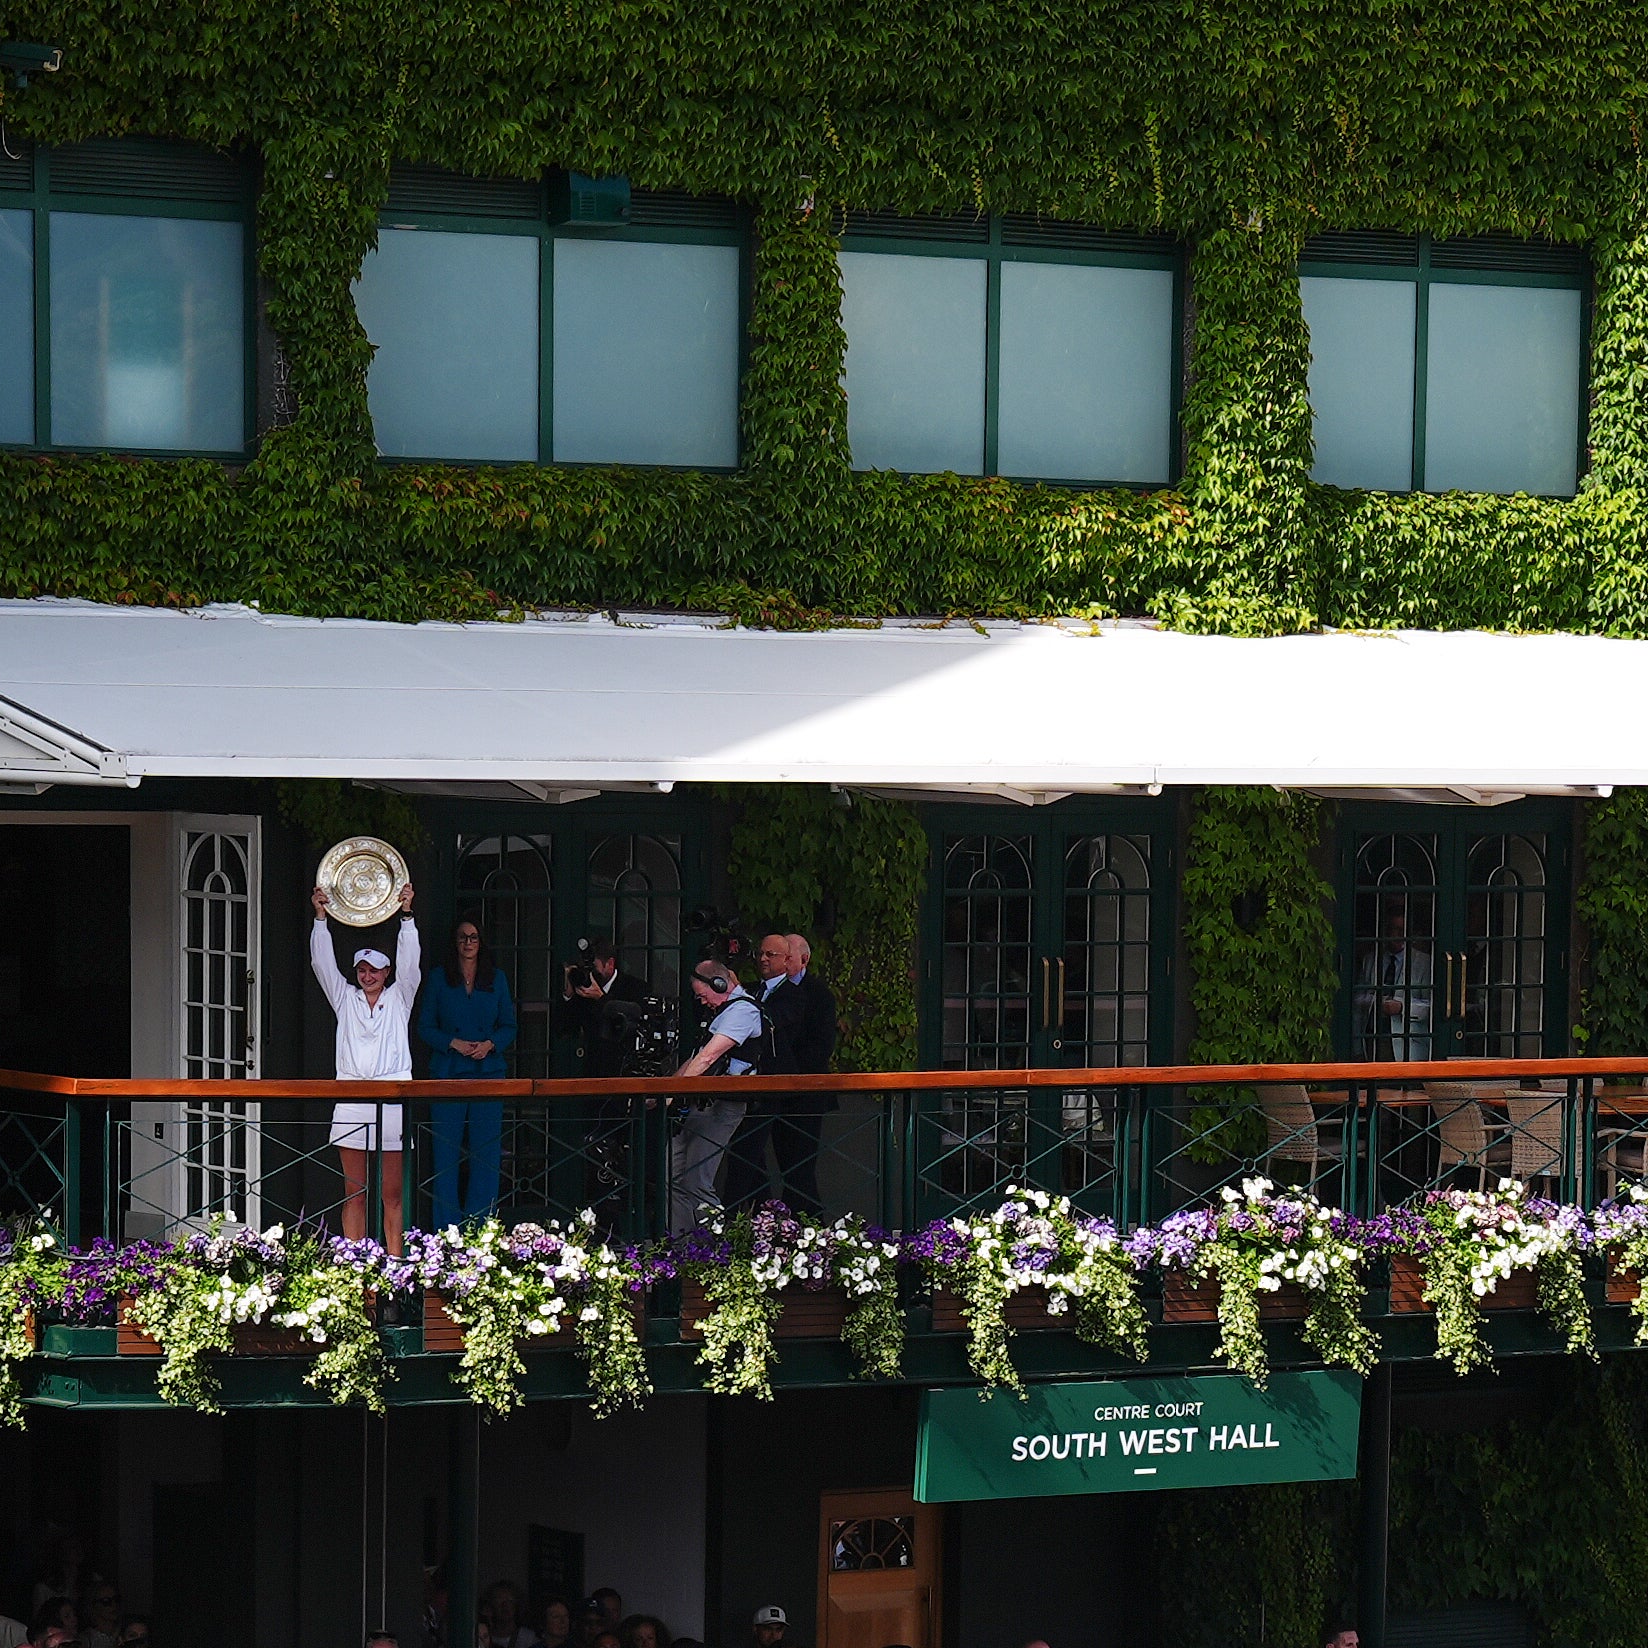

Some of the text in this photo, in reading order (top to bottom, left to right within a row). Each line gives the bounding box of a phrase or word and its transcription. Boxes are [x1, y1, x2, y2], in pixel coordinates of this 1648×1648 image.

[1094, 1401, 1204, 1422] CENTRE COURT
[1011, 1422, 1280, 1462] SOUTH WEST HALL
